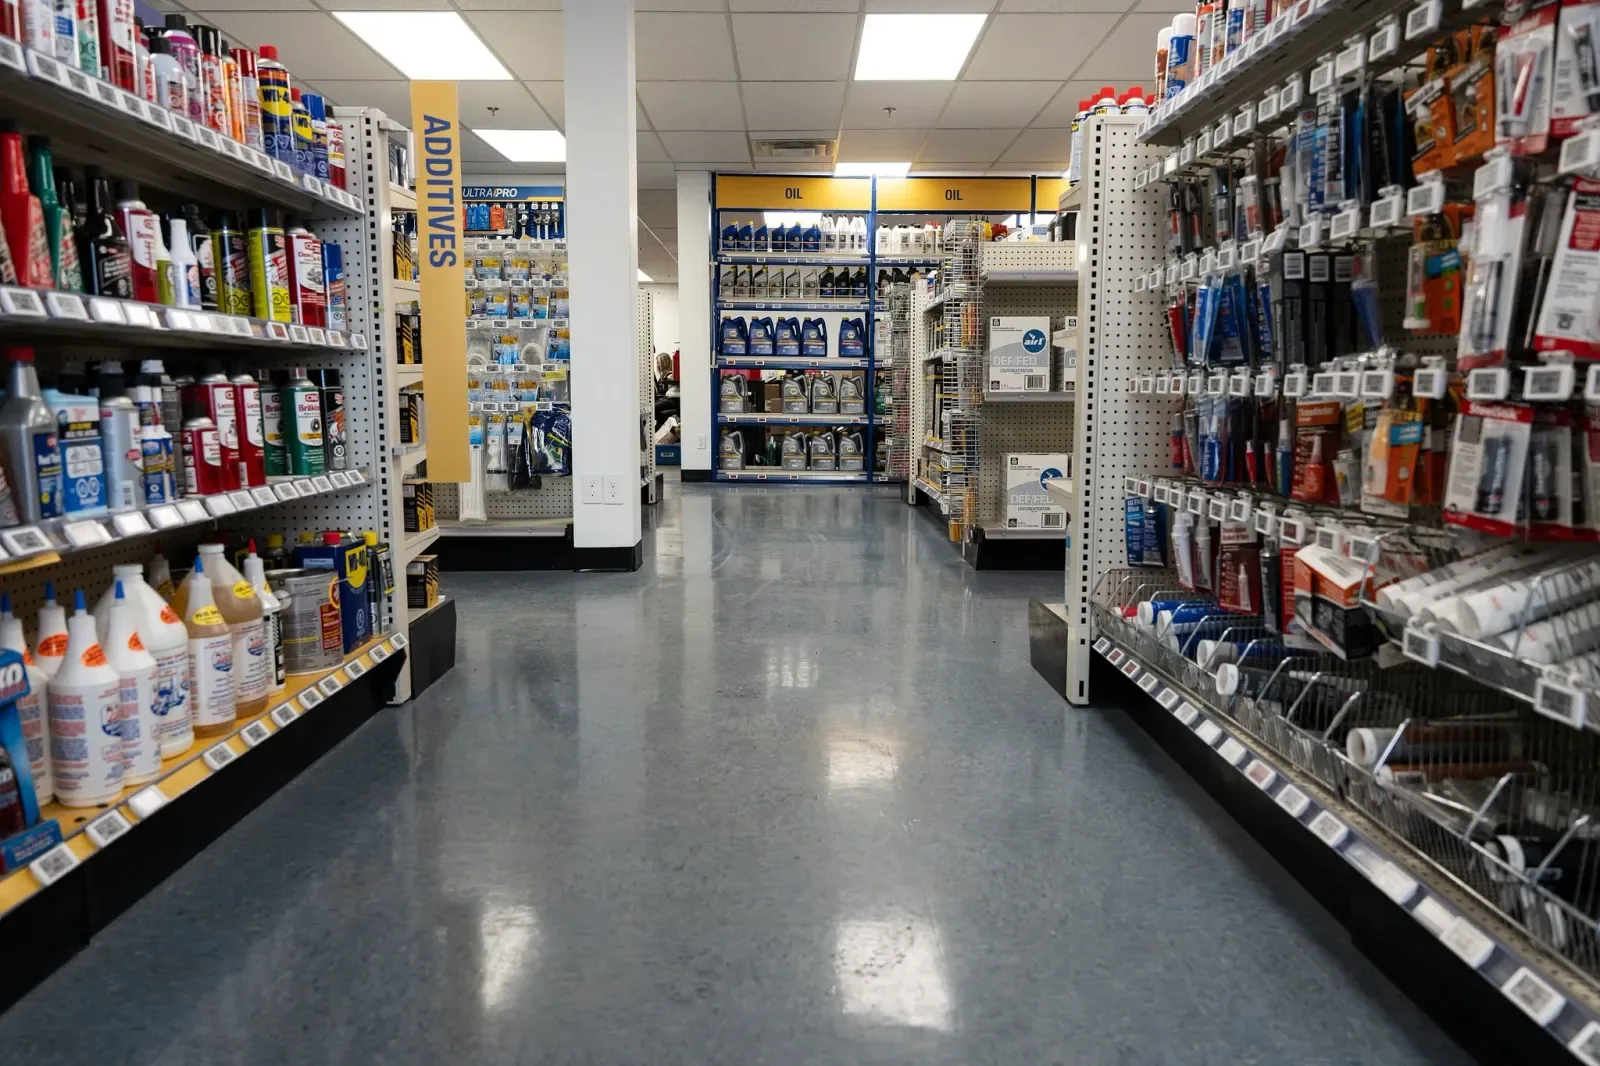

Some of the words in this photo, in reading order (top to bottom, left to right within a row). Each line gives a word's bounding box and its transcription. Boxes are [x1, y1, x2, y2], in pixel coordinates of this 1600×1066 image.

[262, 88, 290, 103] WD-4
[423, 115, 457, 268] ADDITIVES
[785, 188, 803, 199] OIL
[945, 189, 963, 201] OIL
[993, 356, 1037, 366] DEF/FED
